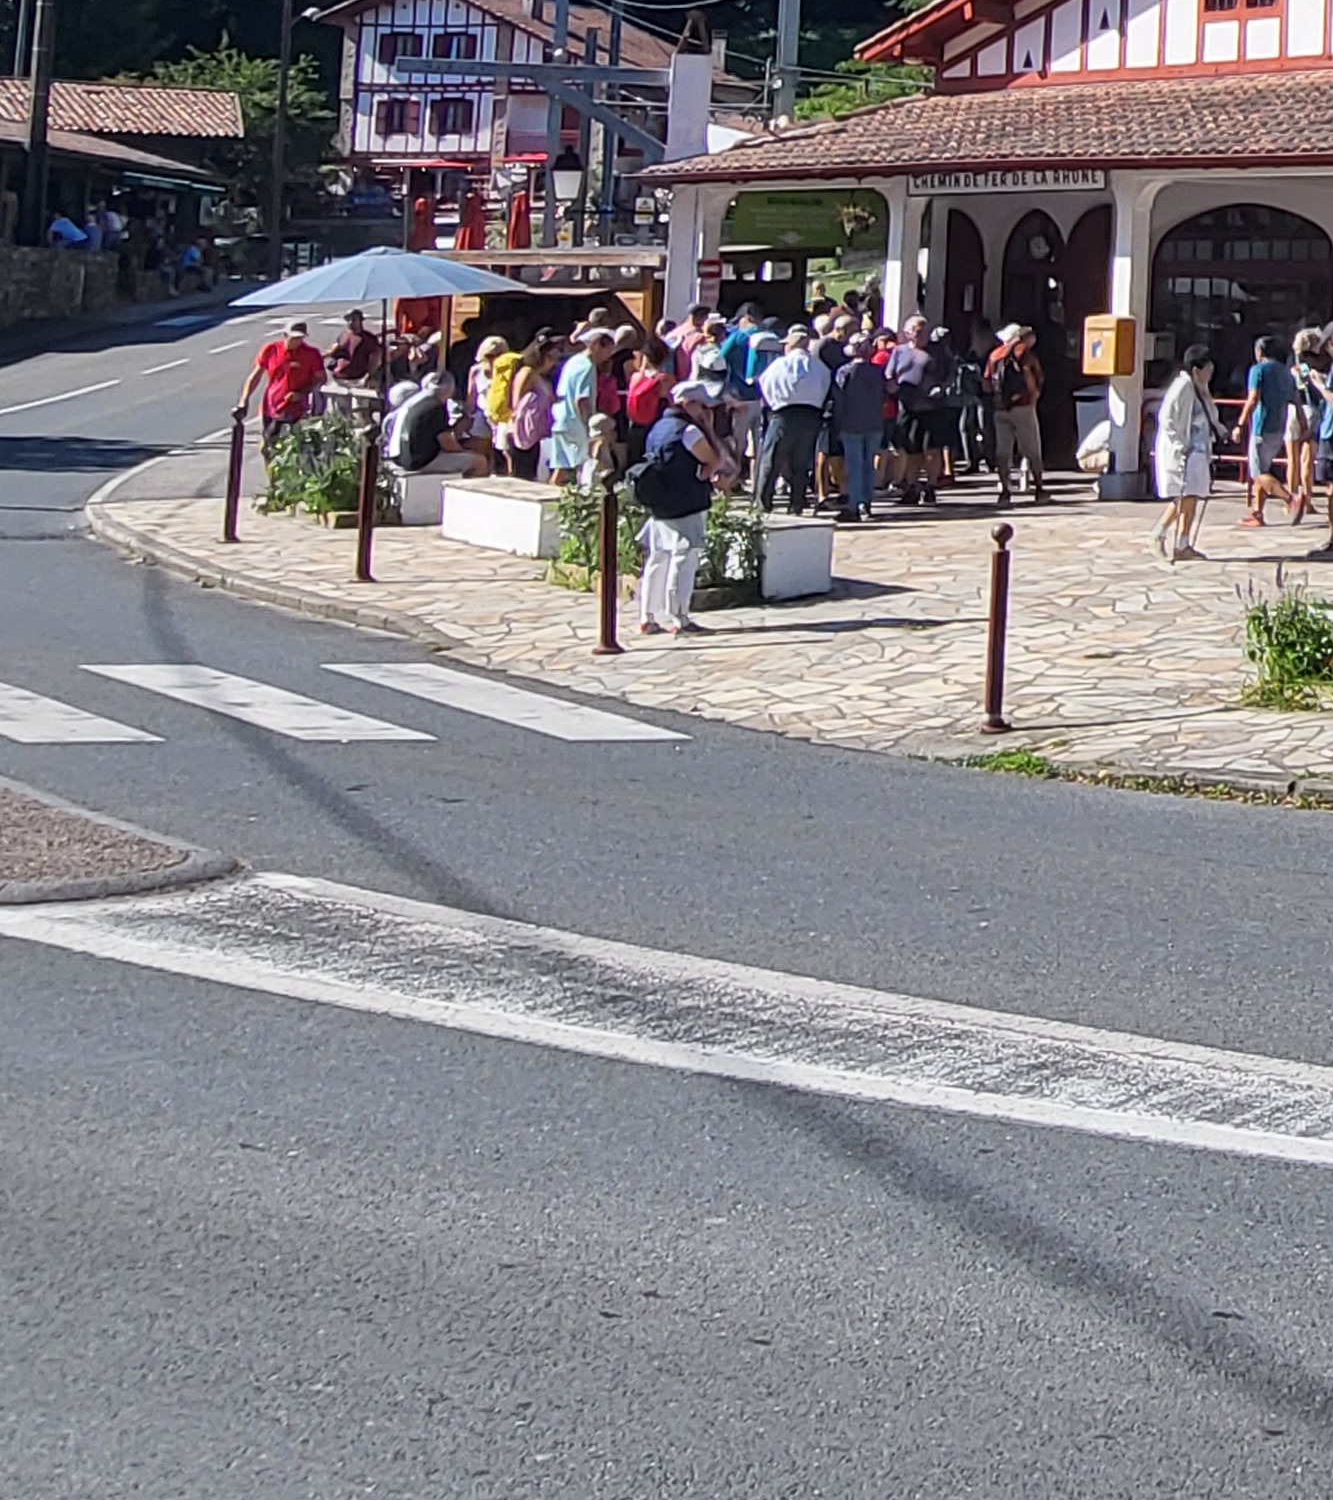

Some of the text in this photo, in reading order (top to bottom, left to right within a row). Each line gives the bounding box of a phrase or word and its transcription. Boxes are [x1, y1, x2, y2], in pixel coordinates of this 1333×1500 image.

[913, 169, 1099, 188] CHEMIN DE FER DE LA RHUNE
